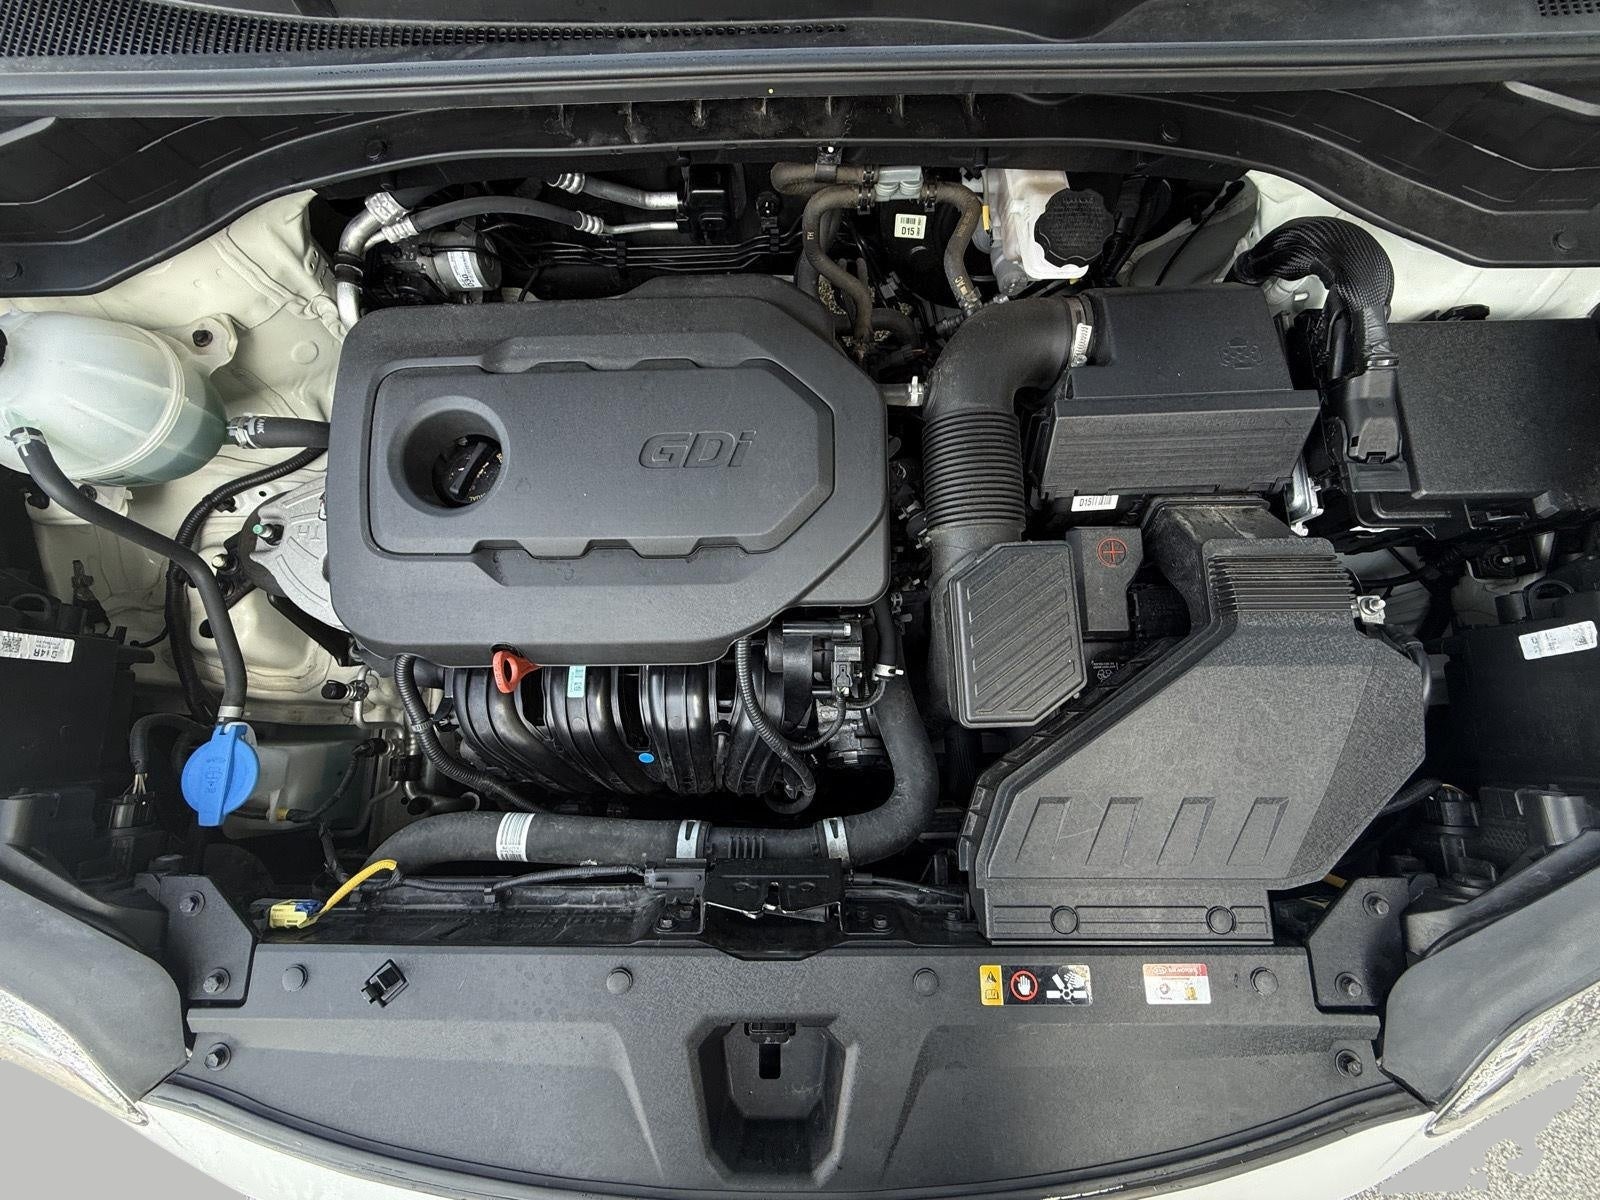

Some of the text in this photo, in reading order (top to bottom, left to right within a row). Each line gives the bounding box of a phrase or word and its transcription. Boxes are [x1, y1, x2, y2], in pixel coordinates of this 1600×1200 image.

[901, 226, 915, 236] D15
[638, 429, 757, 469] GDi
[1079, 497, 1092, 507] D15
